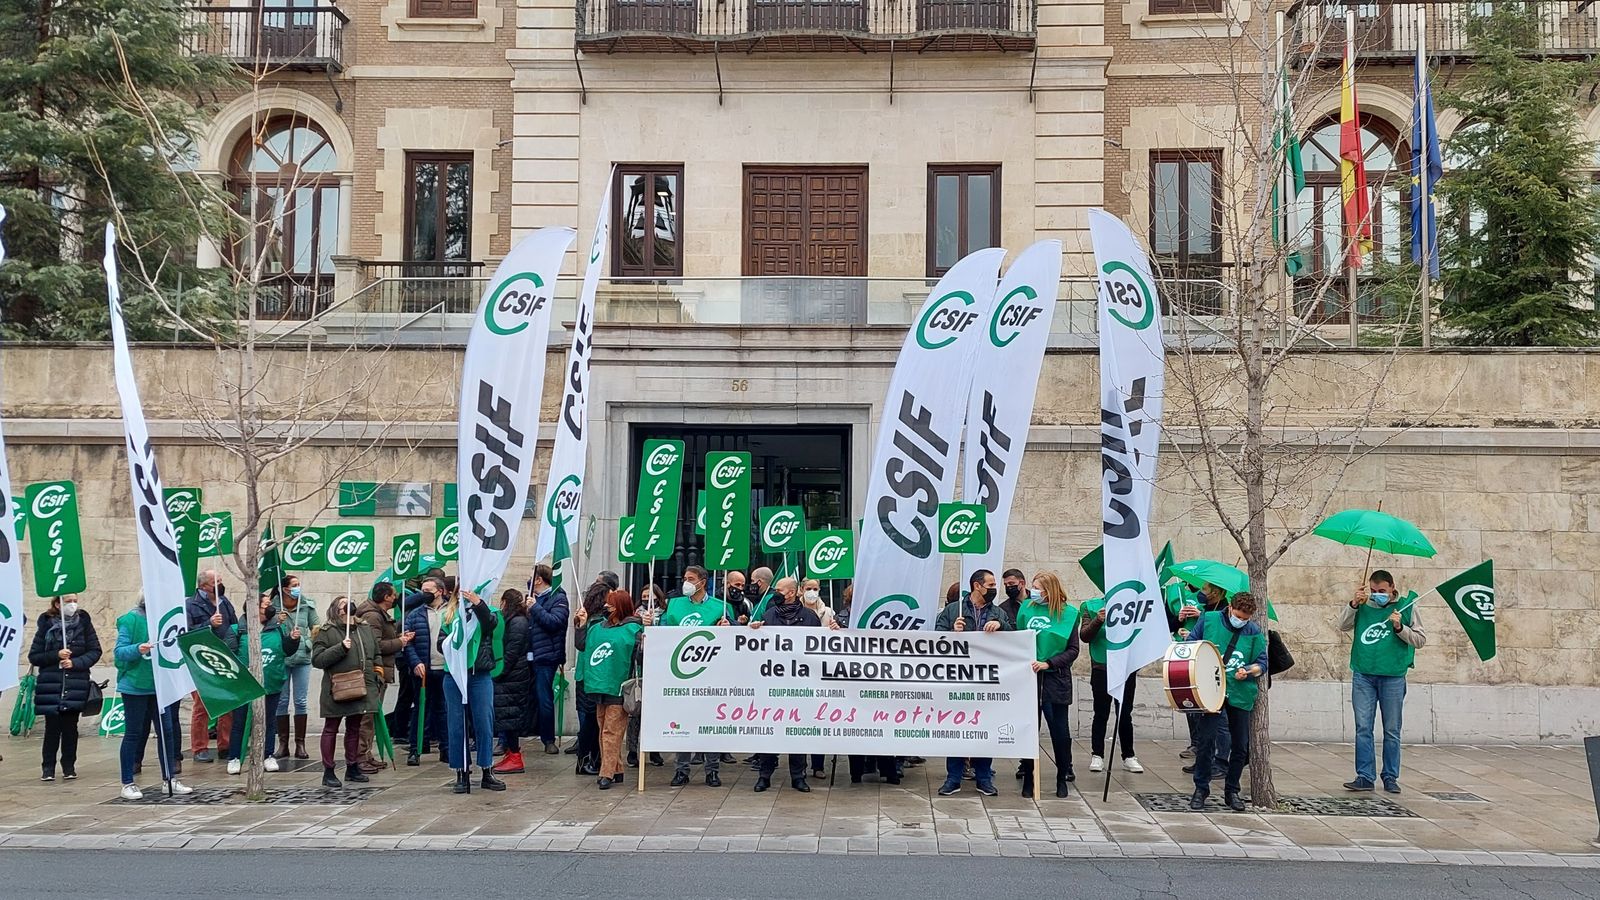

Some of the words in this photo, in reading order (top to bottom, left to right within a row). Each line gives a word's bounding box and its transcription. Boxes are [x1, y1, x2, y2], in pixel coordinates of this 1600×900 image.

[499, 291, 546, 317] CSIF
[929, 308, 979, 332] CSIF
[1000, 304, 1043, 327] CSIF
[731, 380, 748, 391] 56
[467, 379, 524, 551] CSIF
[653, 454, 679, 465] CSIF
[717, 466, 746, 478] CSIF
[877, 389, 950, 559] CSIF
[975, 389, 1011, 551] SIF
[39, 494, 71, 508] CSIF
[168, 501, 197, 512] CSIF
[645, 480, 667, 550] CSIF
[199, 527, 228, 541] CSIF
[720, 492, 736, 565] CSIF
[770, 521, 800, 535] CSIF
[949, 520, 981, 535] CSIF
[292, 542, 324, 555] CSIF
[336, 542, 369, 554] CSIF
[816, 547, 848, 561] CSIF
[48, 520, 68, 592] CSIF
[398, 549, 417, 563] CSIF
[1106, 600, 1154, 628] CSIF
[735, 634, 769, 651] Por
[775, 634, 793, 651] la
[805, 635, 969, 655] DIGNIFICACIÓN
[680, 645, 721, 662] CSIF
[201, 652, 238, 679] CSIF
[760, 660, 785, 677] de
[791, 660, 809, 677] la
[821, 661, 894, 679] LABOR
[900, 663, 999, 681] DOCENTE
[663, 687, 690, 696] DEFENSA
[692, 686, 727, 696] ENSEÑANZA
[729, 686, 755, 697] PÚBLICA
[768, 687, 814, 698] EQUIPARACIÓN
[816, 689, 846, 698] SALARIAL
[859, 690, 889, 699] CARRERA
[890, 690, 933, 700] PROFESIONAL
[949, 692, 975, 701] BAJADA
[977, 692, 985, 701] DE
[987, 692, 1010, 702] RATIOS
[716, 699, 801, 722] Sobran
[814, 702, 857, 722] los
[873, 705, 981, 725] motivos
[698, 724, 737, 735] AMPLIACIÓN
[739, 726, 774, 736] PLANTILLAS
[785, 725, 821, 736] REDUCCIÓN
[823, 727, 831, 736] DE
[833, 727, 841, 737] LA
[843, 728, 884, 738] BUROCRACIA
[894, 727, 930, 738] REDUCCIÓN
[932, 729, 961, 739] HORARIO
[962, 730, 988, 740] LECTIVO
